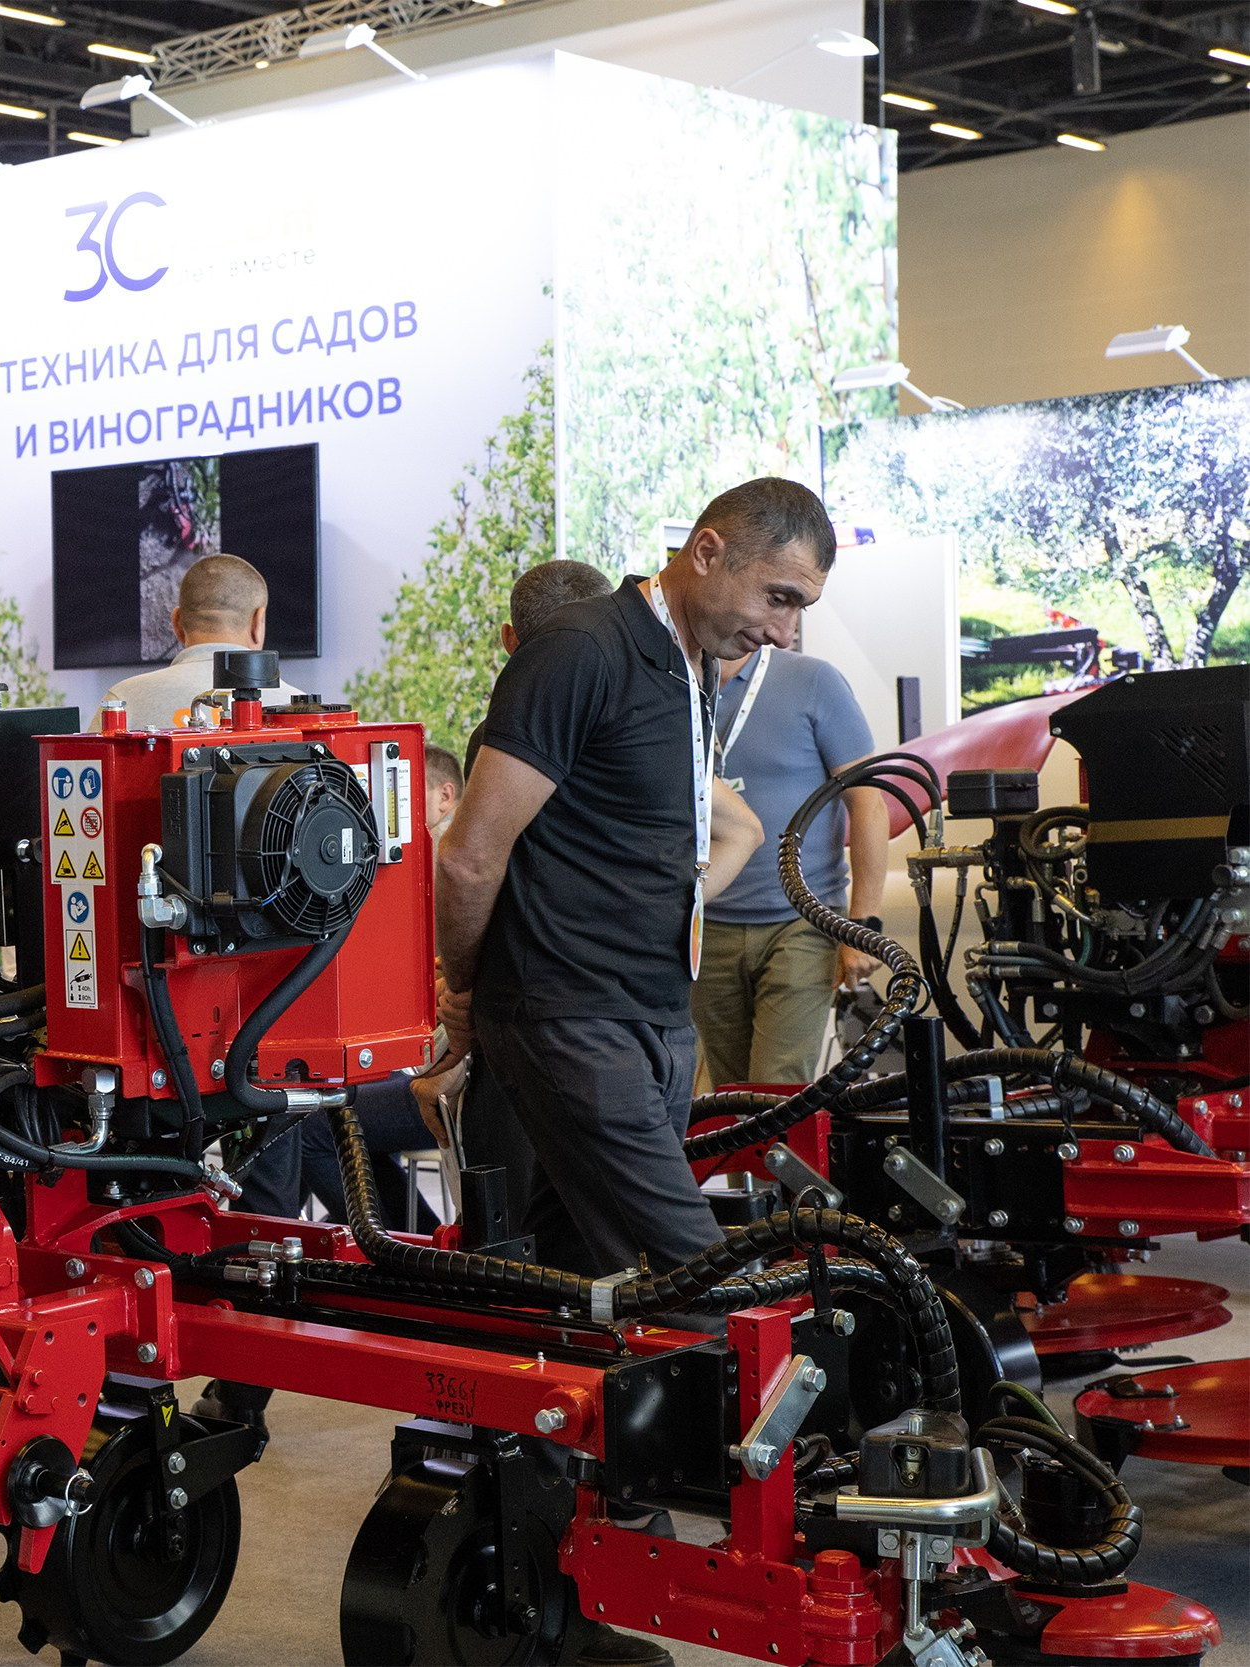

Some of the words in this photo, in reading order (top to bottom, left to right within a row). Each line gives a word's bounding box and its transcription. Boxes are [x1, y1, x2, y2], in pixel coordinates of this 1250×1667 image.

[0, 338, 168, 394] ТЕХНИКА
[177, 323, 260, 377] ДЛЯ
[271, 300, 418, 356] САДОВ
[15, 424, 38, 458] И
[48, 376, 403, 456] ВИНОГРАДНИКОВ
